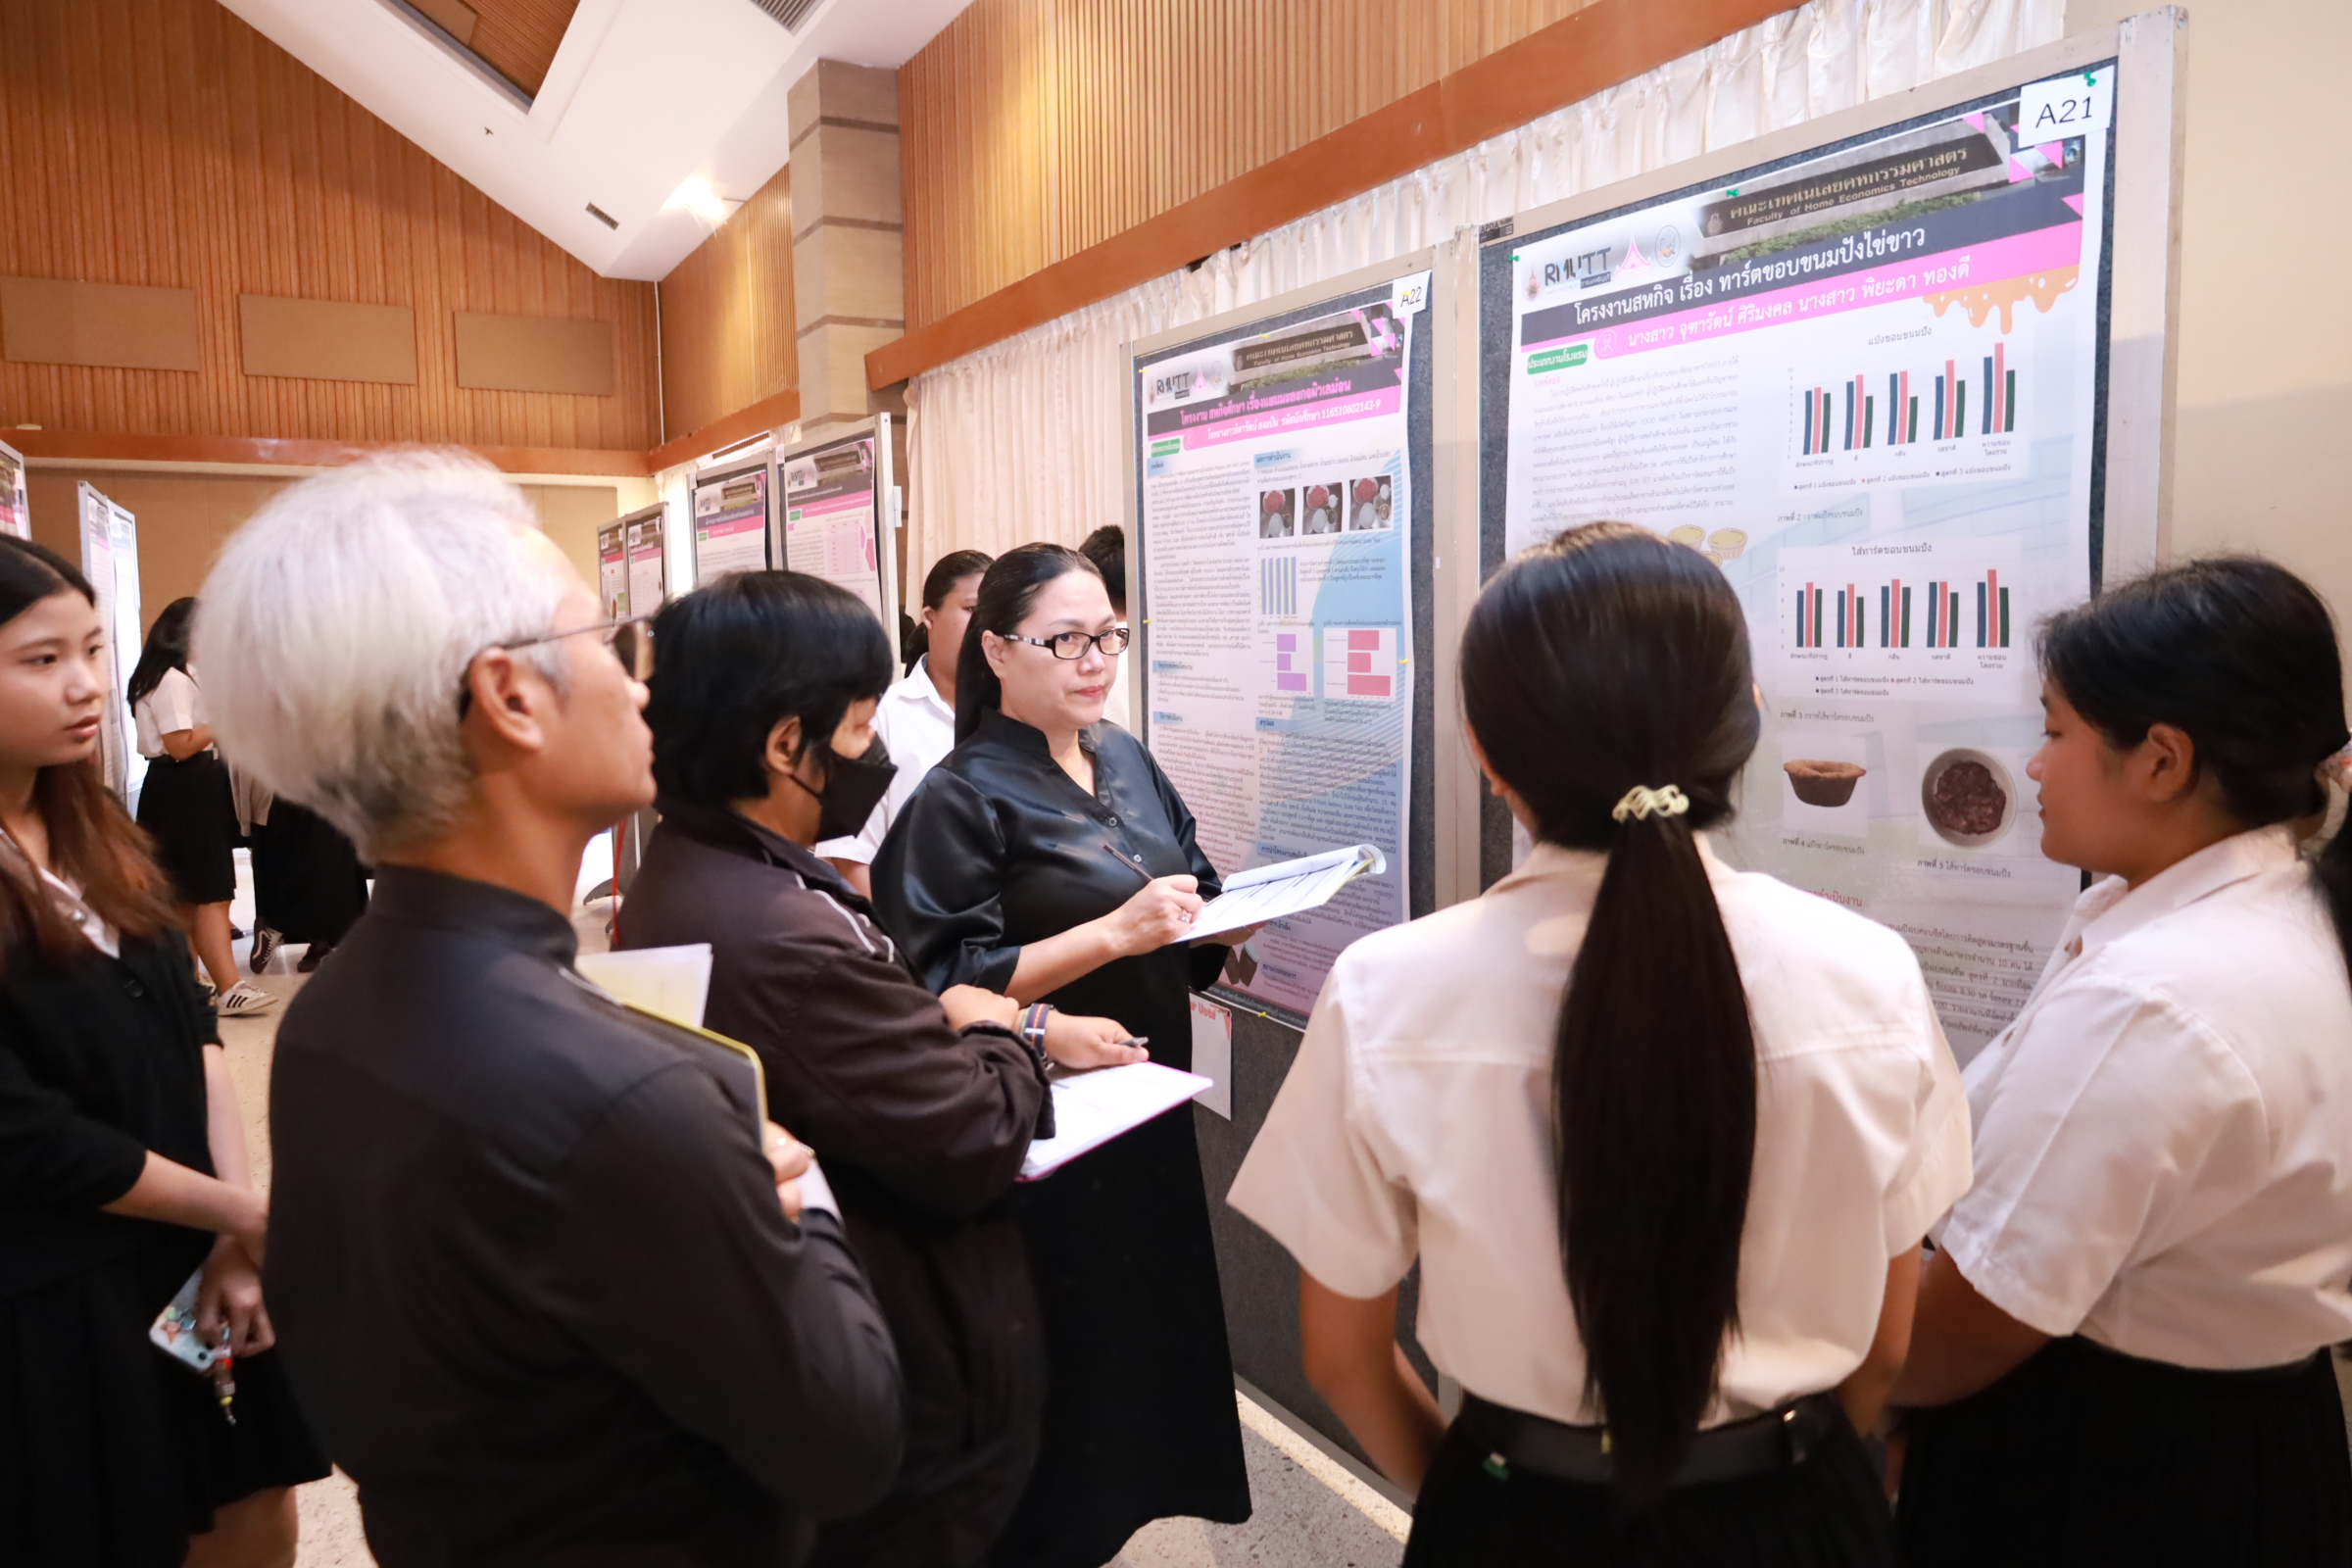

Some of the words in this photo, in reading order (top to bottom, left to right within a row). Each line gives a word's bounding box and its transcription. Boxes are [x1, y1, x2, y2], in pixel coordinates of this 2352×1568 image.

[2035, 96, 2092, 128] A21
[1747, 212, 1784, 225] Faculty
[1789, 206, 1800, 215] of
[1805, 199, 1835, 212] Home
[1838, 183, 1895, 203] Economics
[1899, 167, 1960, 187] Technology
[1544, 247, 1611, 286] RMUTT
[1574, 283, 1674, 324] โครงงานสหกิจ
[1680, 270, 1712, 301] เรื่อง
[1719, 227, 1925, 292] ทาร์ตขอบขนมปังไข่ขาว
[1400, 286, 1421, 307] A22
[1628, 324, 1674, 347] นางสาว
[1679, 306, 1734, 342] จุฑารัตน์
[1738, 300, 1792, 330] ศิริมงคล
[1797, 287, 1855, 313] นางสาว
[1861, 273, 1917, 298] พิยะดา
[1923, 255, 1971, 286] ทองดี
[1917, 858, 1937, 869] ภาพที่
[1998, 958, 2007, 967] 10
